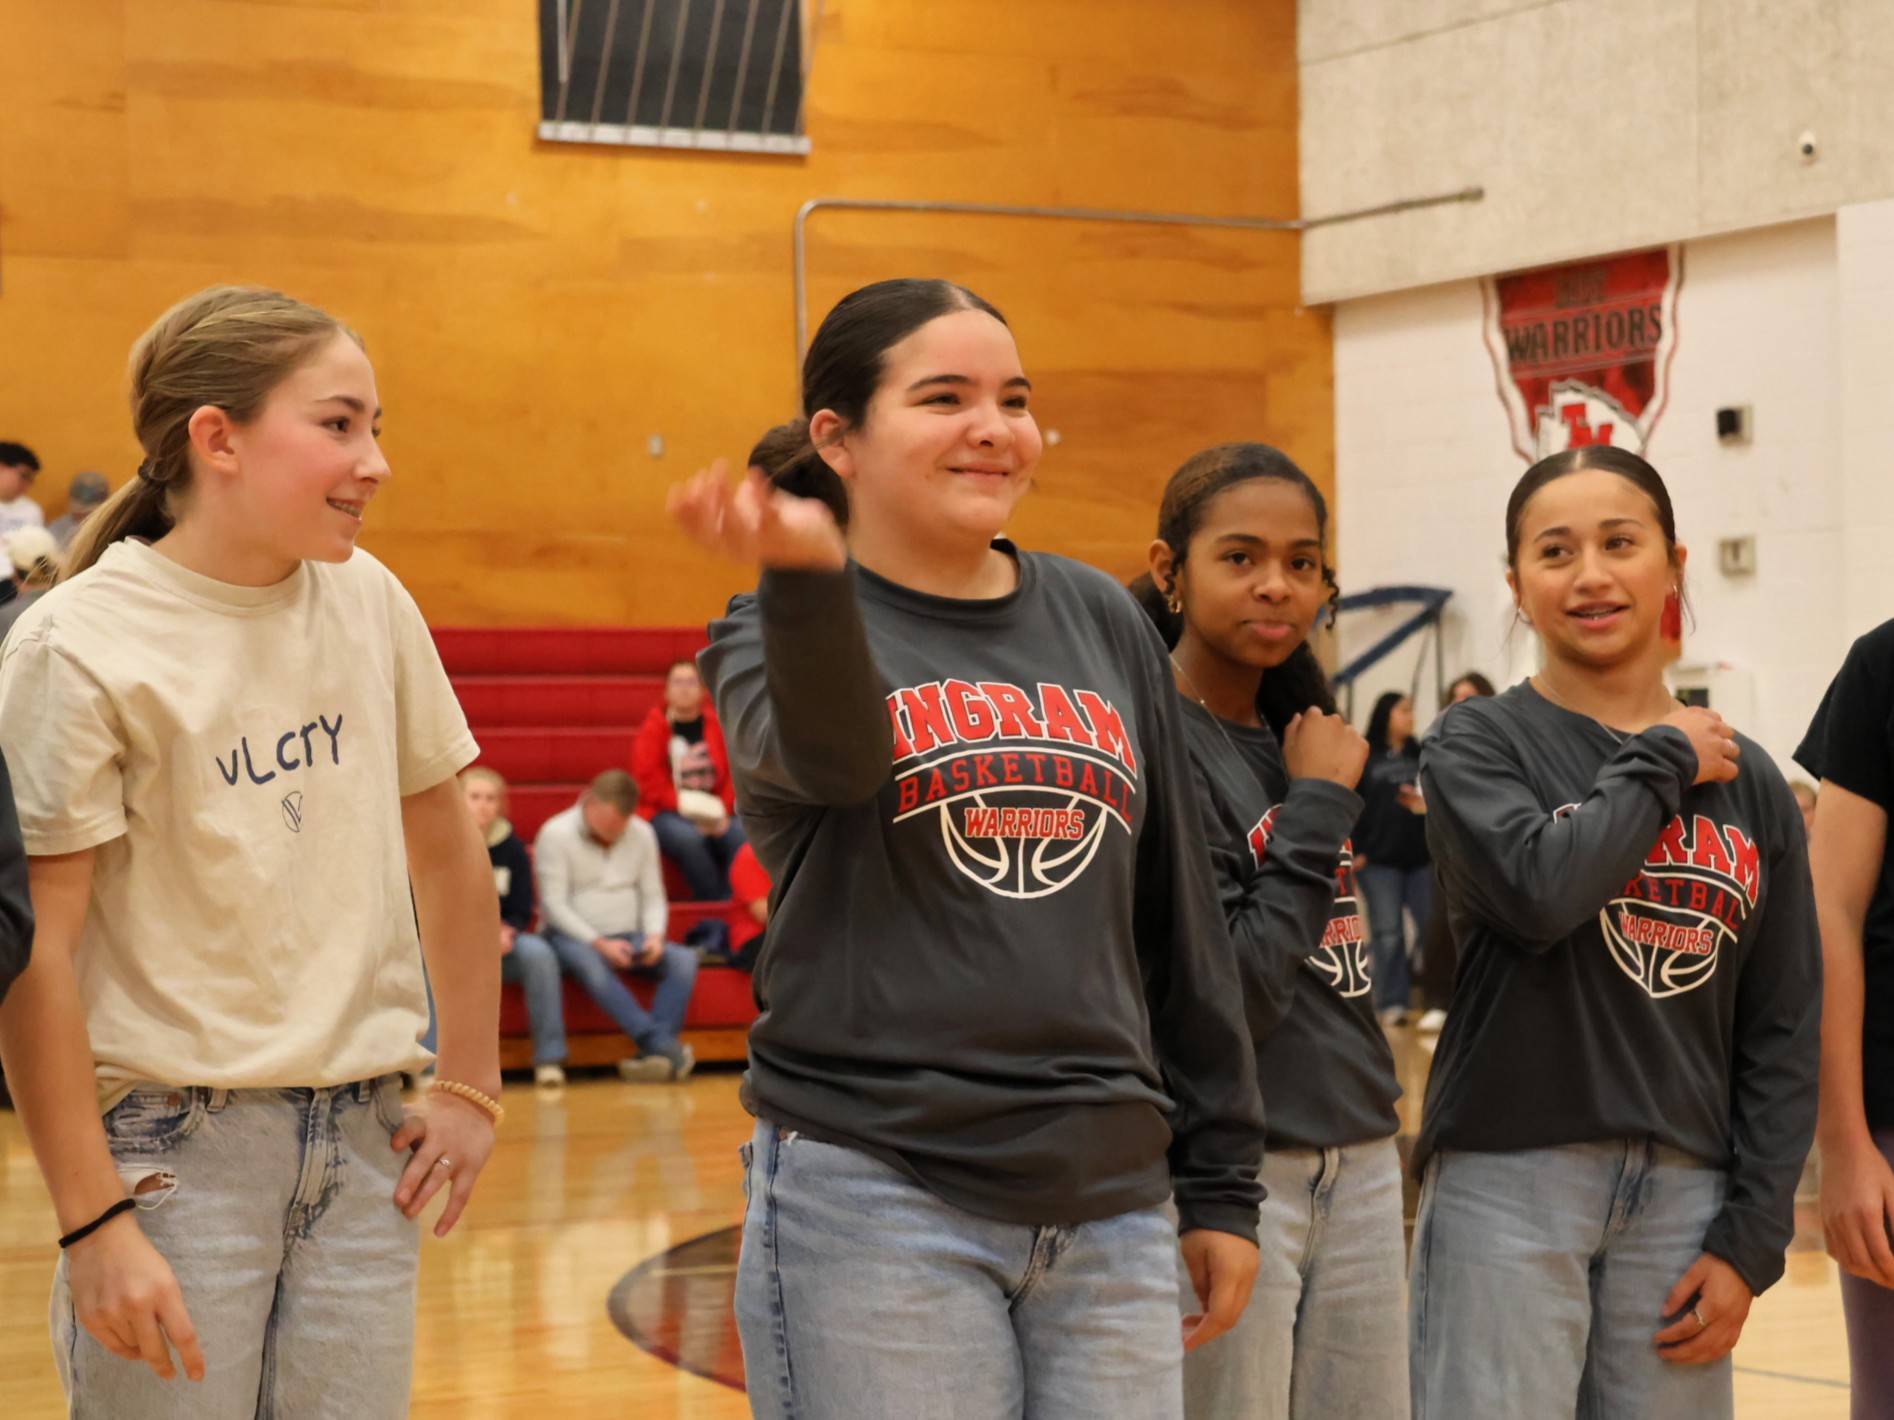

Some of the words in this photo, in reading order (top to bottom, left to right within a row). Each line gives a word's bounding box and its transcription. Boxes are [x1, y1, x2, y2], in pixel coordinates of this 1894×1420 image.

[1505, 304, 1662, 362] WARRIORS
[885, 678, 1137, 779] INGRAM
[898, 753, 1132, 823] BASKETBALL
[964, 807, 1084, 840] WARRIORS
[1644, 814, 1760, 909] RAM
[1622, 873, 1740, 930] KETBAL
[1618, 911, 1713, 956] WARRIORS
